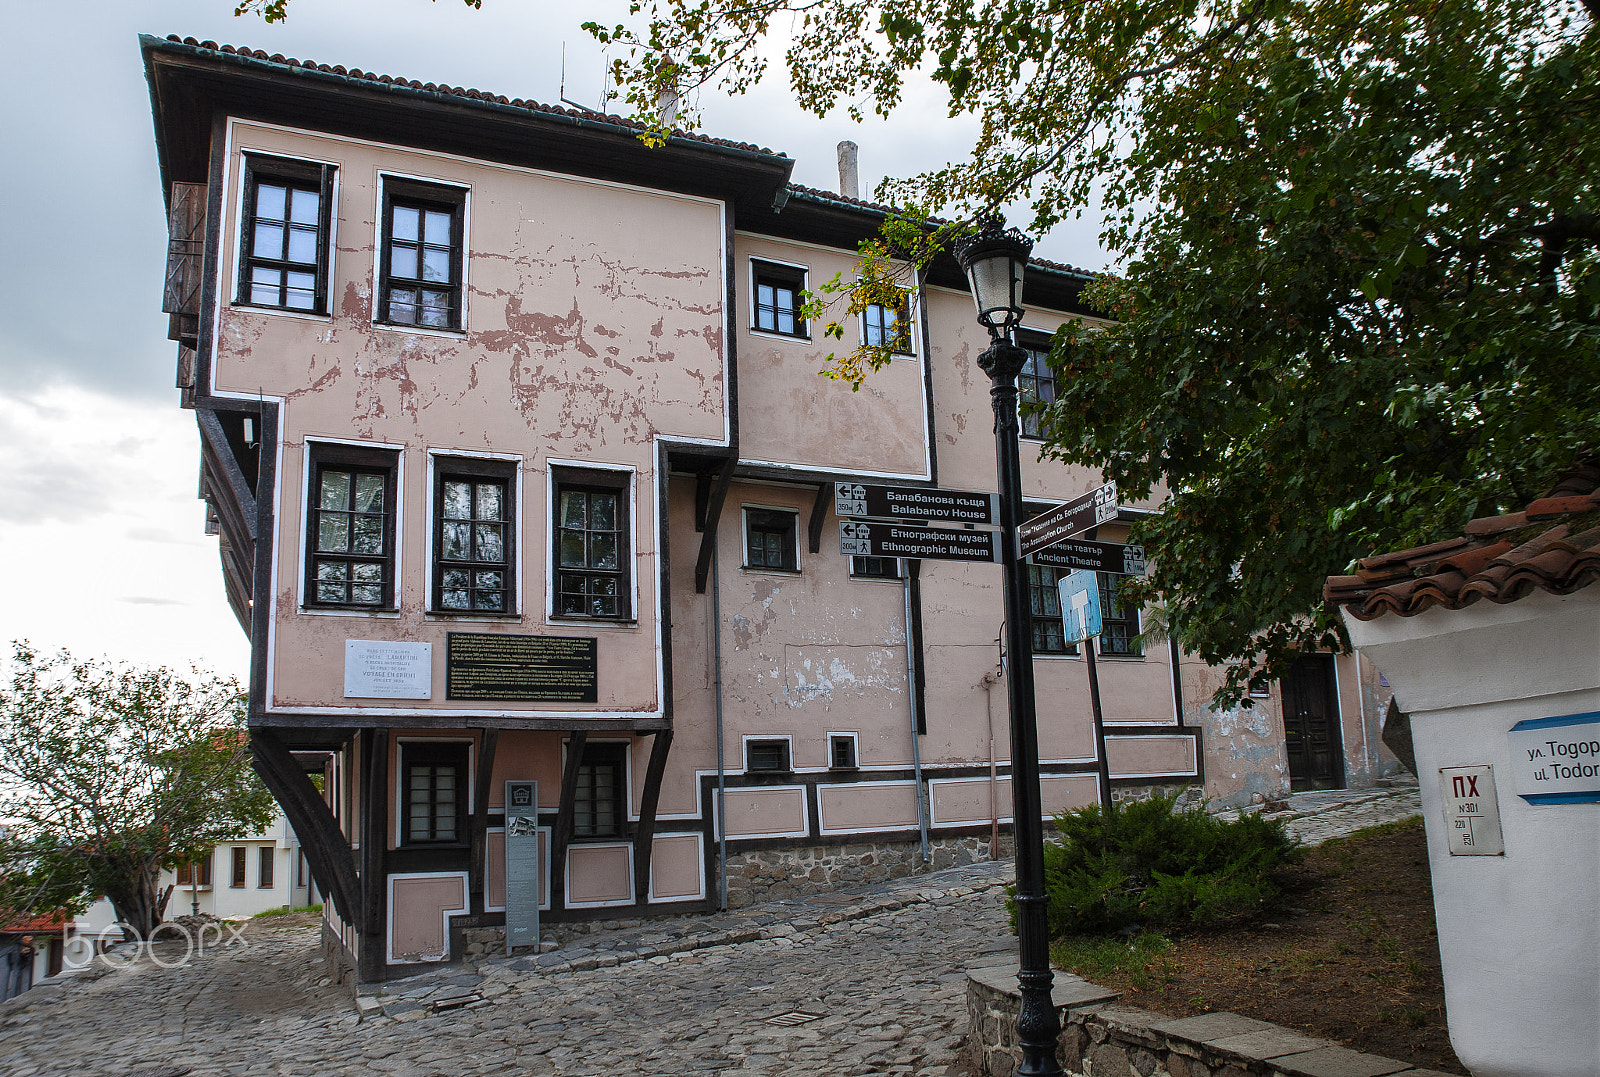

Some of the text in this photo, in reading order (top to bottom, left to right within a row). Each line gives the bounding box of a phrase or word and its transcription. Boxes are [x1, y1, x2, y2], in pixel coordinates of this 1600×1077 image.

[886, 491, 985, 508] Балабанова къща
[891, 504, 986, 519] Balabanov House
[1056, 521, 1074, 535] Church
[890, 528, 989, 544] Етнографски музей
[881, 541, 989, 556] Ethnographic Museum
[1073, 544, 1103, 556] театър
[1037, 552, 1102, 567] Ancient Theatre
[1527, 748, 1547, 762] ул.
[1533, 762, 1600, 781] ul. Todor
[1452, 775, 1480, 798] ПХ
[1455, 820, 1466, 829] 220
[1462, 833, 1472, 846] 230
